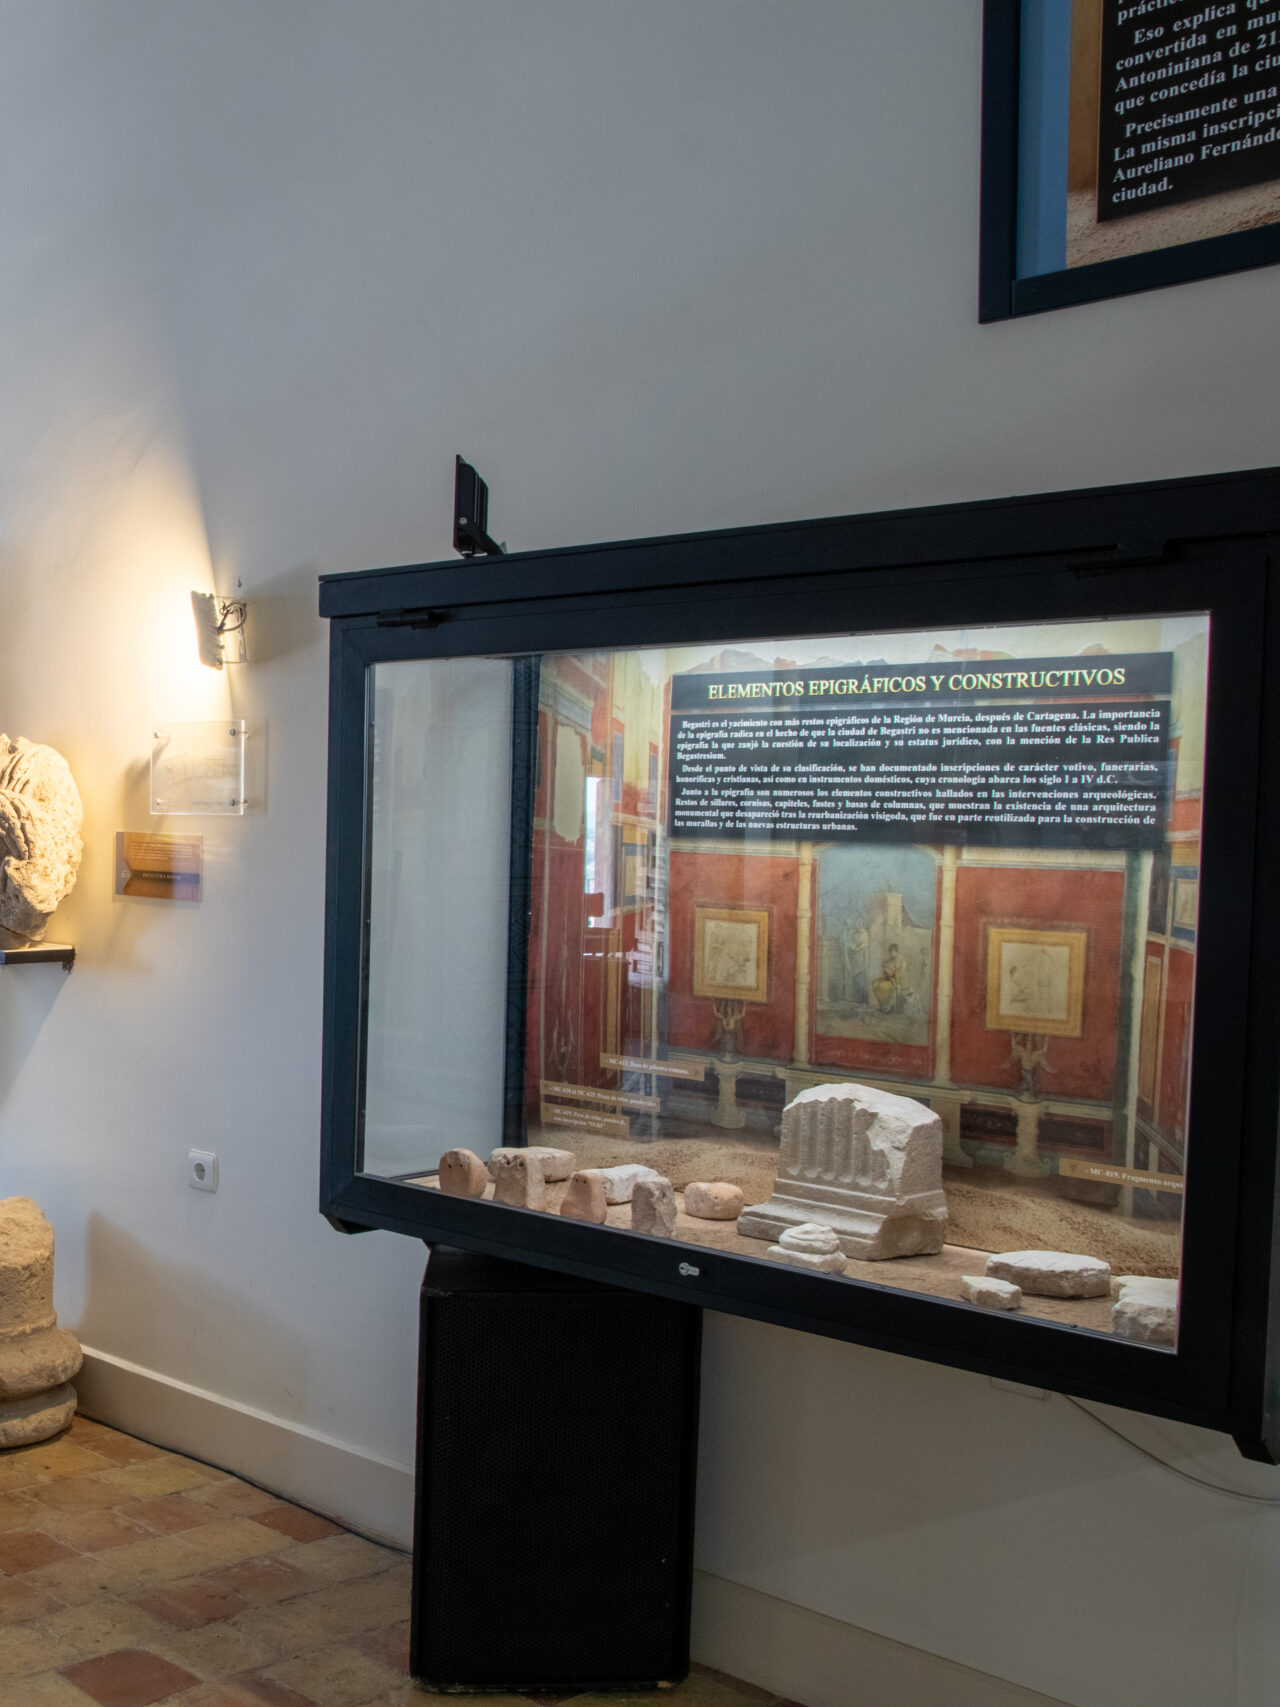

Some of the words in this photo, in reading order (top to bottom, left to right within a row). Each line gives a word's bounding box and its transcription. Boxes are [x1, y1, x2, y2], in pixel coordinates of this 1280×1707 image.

[1133, 26, 1164, 45] Eso
[1173, 3, 1236, 31] explica
[1114, 50, 1222, 92] Antoniniana
[1228, 42, 1251, 58] de
[1256, 30, 1280, 50] 21
[1115, 33, 1207, 71] convertida
[1216, 24, 1237, 39] en
[1114, 95, 1145, 115] que
[1150, 70, 1226, 103] concedía
[1231, 64, 1248, 79] la
[1124, 97, 1238, 138] Precisamente
[1243, 85, 1277, 104] una
[1113, 147, 1135, 162] La
[1141, 130, 1197, 155] misma
[1112, 152, 1194, 183] Aureliano
[1112, 177, 1174, 203] ciudad.
[707, 680, 805, 700] ELEMENTOS
[808, 674, 927, 697] EPIGRÁFICOS
[929, 675, 945, 691] Y
[948, 668, 1126, 691] CONSTRUCTIVOS
[682, 718, 710, 731] Begastri
[720, 718, 727, 728] el
[728, 717, 767, 730] yacimiento
[784, 716, 799, 726] más
[801, 716, 824, 726] restos
[825, 714, 869, 728] epigráficos
[870, 714, 881, 724] de
[882, 714, 891, 724] la
[893, 713, 922, 726] Región
[924, 713, 935, 723] de
[937, 712, 972, 724] Murcia,
[974, 711, 1011, 724] después
[1012, 710, 1024, 721] de
[1026, 709, 1079, 723] Cartagena.
[1082, 708, 1096, 719] La
[1098, 707, 1160, 722] importancia
[711, 739, 718, 748] la
[721, 741, 734, 750] que
[738, 738, 758, 750] zanjó
[761, 738, 769, 748] la
[772, 737, 803, 748] cuestión
[806, 737, 816, 747] de
[832, 736, 881, 747] localización
[884, 739, 889, 749] y
[907, 735, 938, 746] estatus
[942, 735, 981, 748] jurídico,
[1006, 734, 1015, 744] la
[1019, 733, 1060, 744] mención
[1064, 733, 1077, 744] de
[1081, 733, 1091, 744] la
[1096, 732, 1114, 743] Res
[1119, 732, 1159, 743] Publica
[682, 762, 702, 772] Desde
[705, 762, 712, 772] el
[714, 762, 736, 774] punto
[738, 762, 747, 772] de
[750, 762, 767, 771] vista
[770, 762, 779, 771] de
[794, 761, 845, 773] clasificación,
[860, 761, 875, 771] han
[878, 761, 937, 771] documentado
[940, 760, 1000, 774] inscripciones
[1003, 760, 1014, 771] de
[1018, 760, 1059, 771] carácter
[1062, 760, 1096, 772] votivo,
[1100, 760, 1158, 772] funerarias,
[716, 776, 720, 785] y
[722, 773, 761, 784] cristianas,
[762, 773, 773, 783] así
[808, 773, 862, 783] instrumentos
[863, 773, 912, 784] domésticos,
[914, 775, 935, 785] cuya
[937, 772, 986, 785] cronología
[988, 772, 1020, 783] abarca
[1022, 772, 1036, 783] los
[1064, 772, 1069, 783] I
[1080, 772, 1093, 783] IV
[1096, 772, 1118, 783] d.C.
[681, 786, 701, 795] Junto
[711, 786, 718, 795] la
[816, 786, 828, 796] los
[831, 786, 872, 796] elementos
[874, 786, 932, 797] constructivos
[935, 787, 973, 797] hallados
[991, 787, 1004, 797] las
[1008, 787, 1078, 798] intervenciones
[1082, 787, 1156, 801] arqueológicas.
[1122, 1172, 1162, 1184] Fragmento
